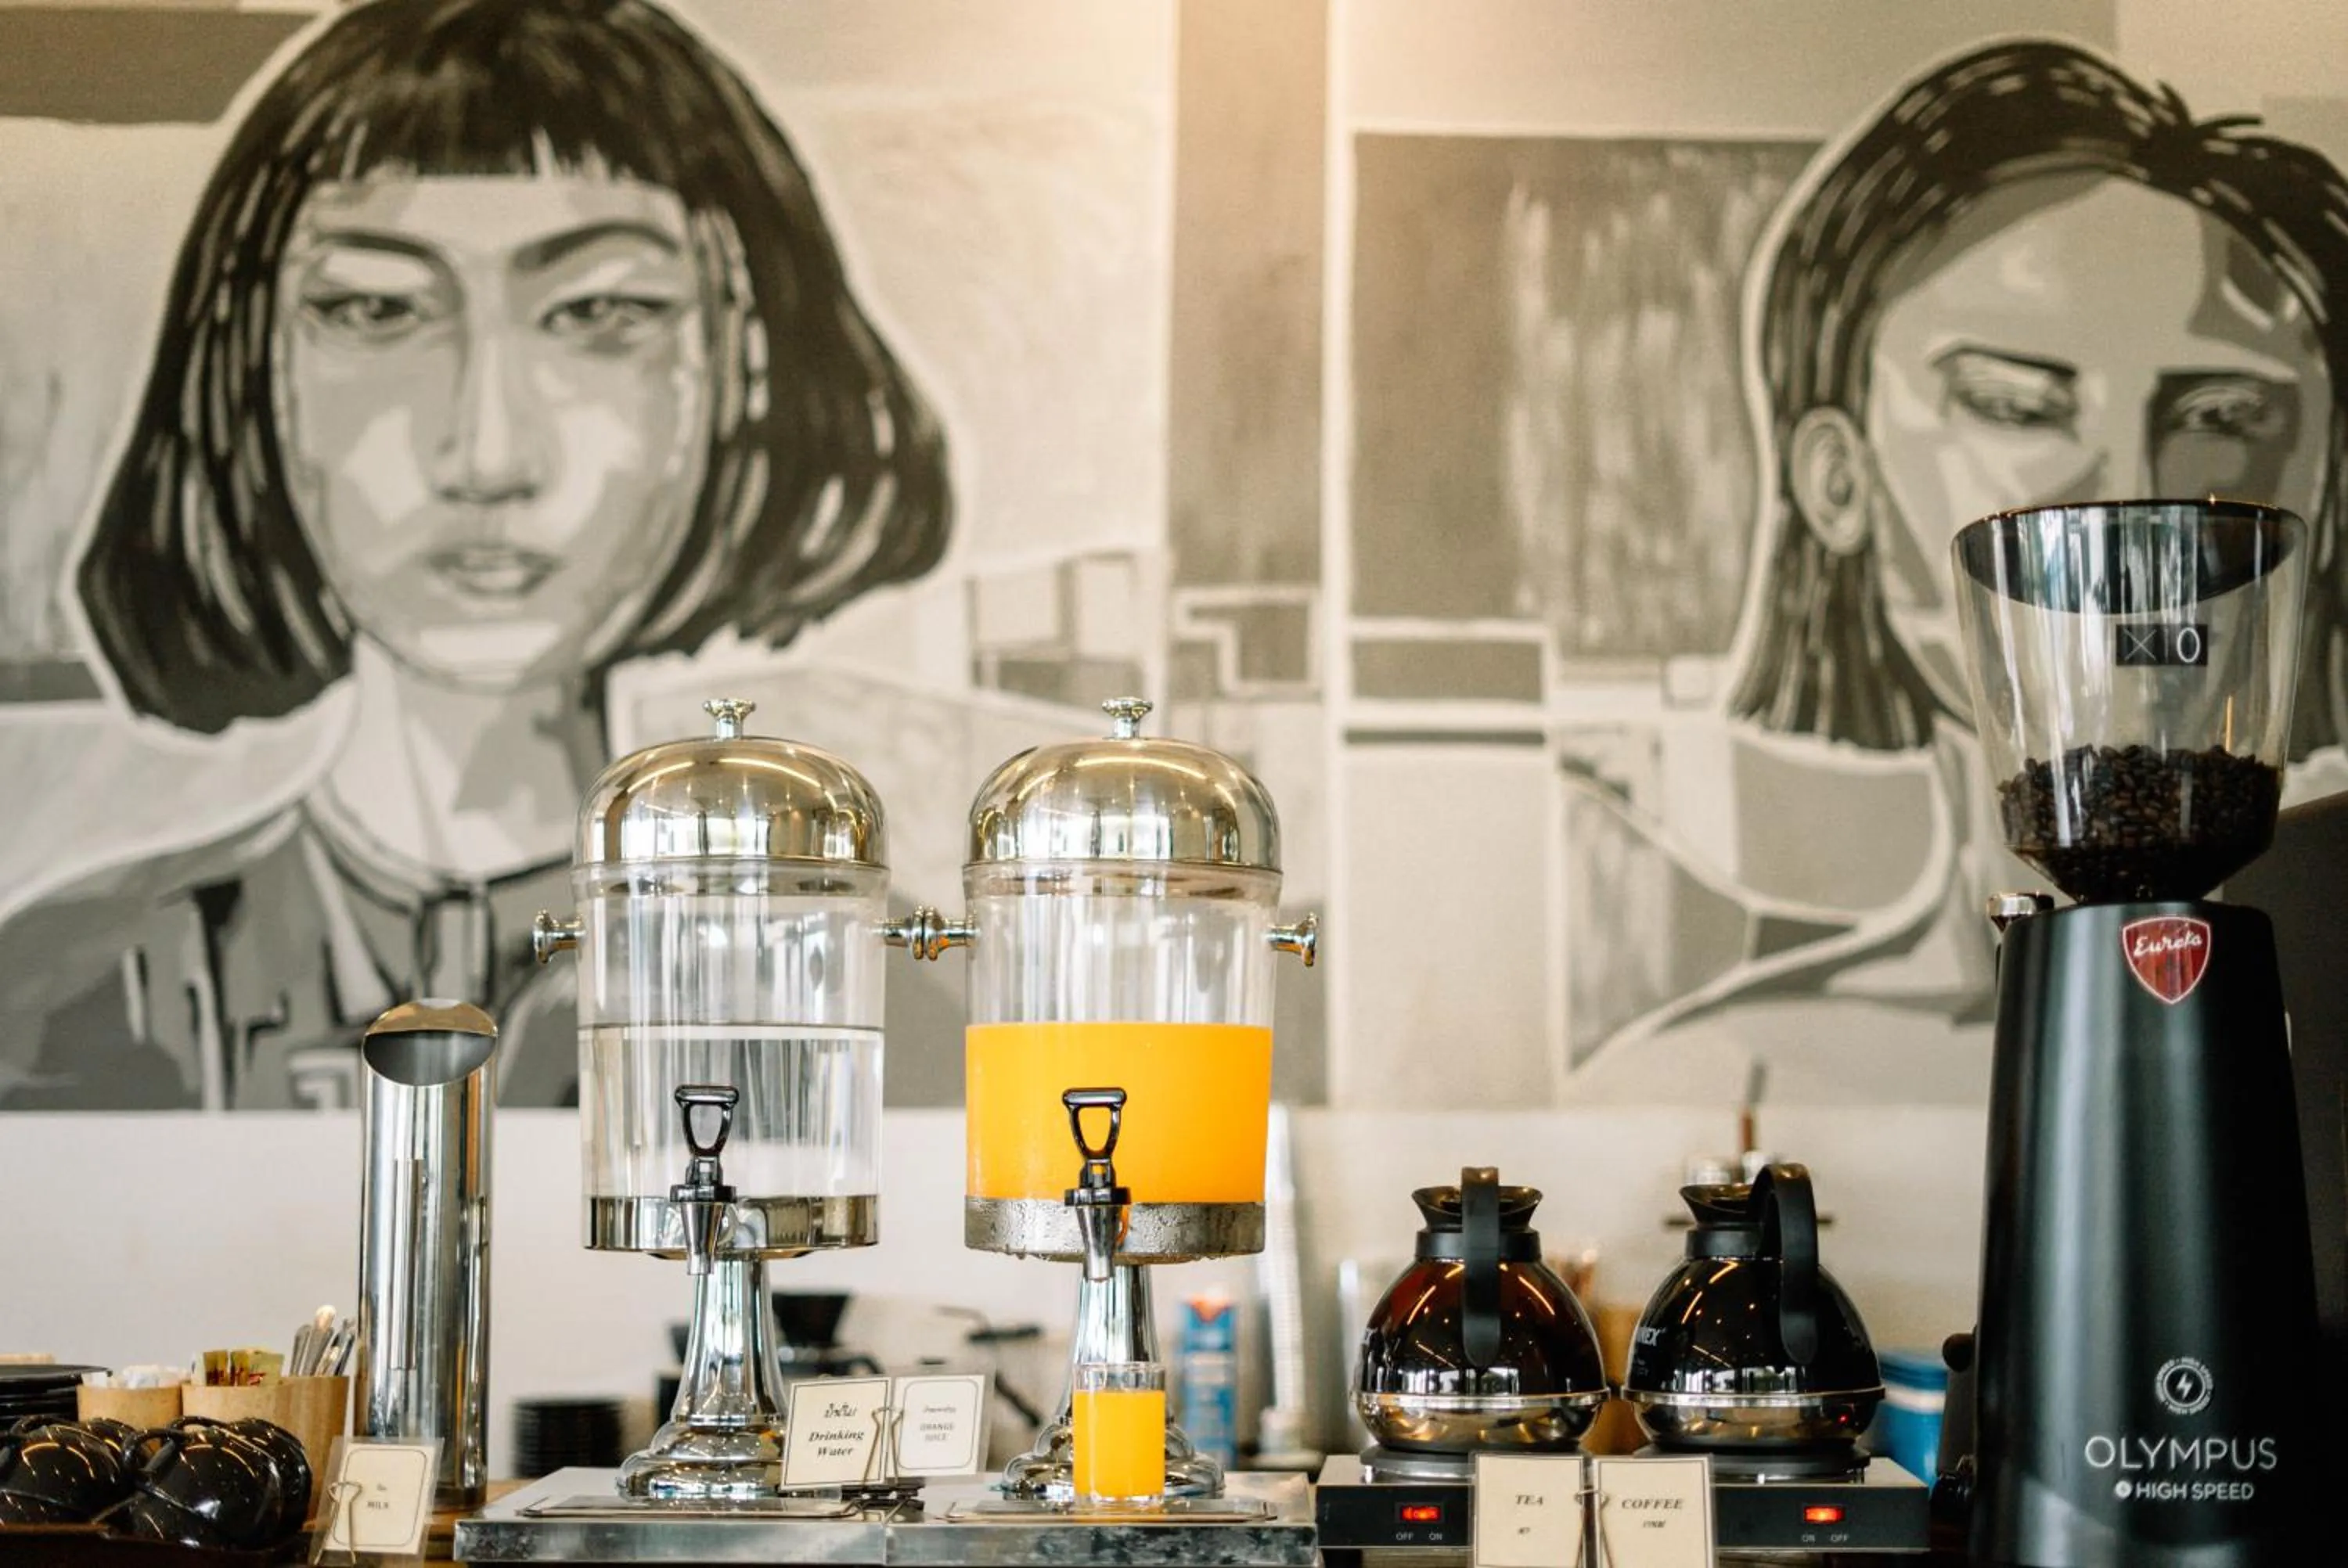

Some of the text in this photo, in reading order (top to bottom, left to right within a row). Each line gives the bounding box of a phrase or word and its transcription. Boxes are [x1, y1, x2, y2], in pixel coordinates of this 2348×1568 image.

[808, 1430, 865, 1443] Drinking
[817, 1447, 854, 1458] Water
[2084, 1435, 2278, 1470] OLYMPUS
[2136, 1482, 2255, 1500] HIGH SPEED
[1515, 1494, 1544, 1506] TEA
[1621, 1498, 1684, 1510] COFFEE
[1802, 1534, 1816, 1543] ON
[1830, 1534, 1850, 1543] OFF
